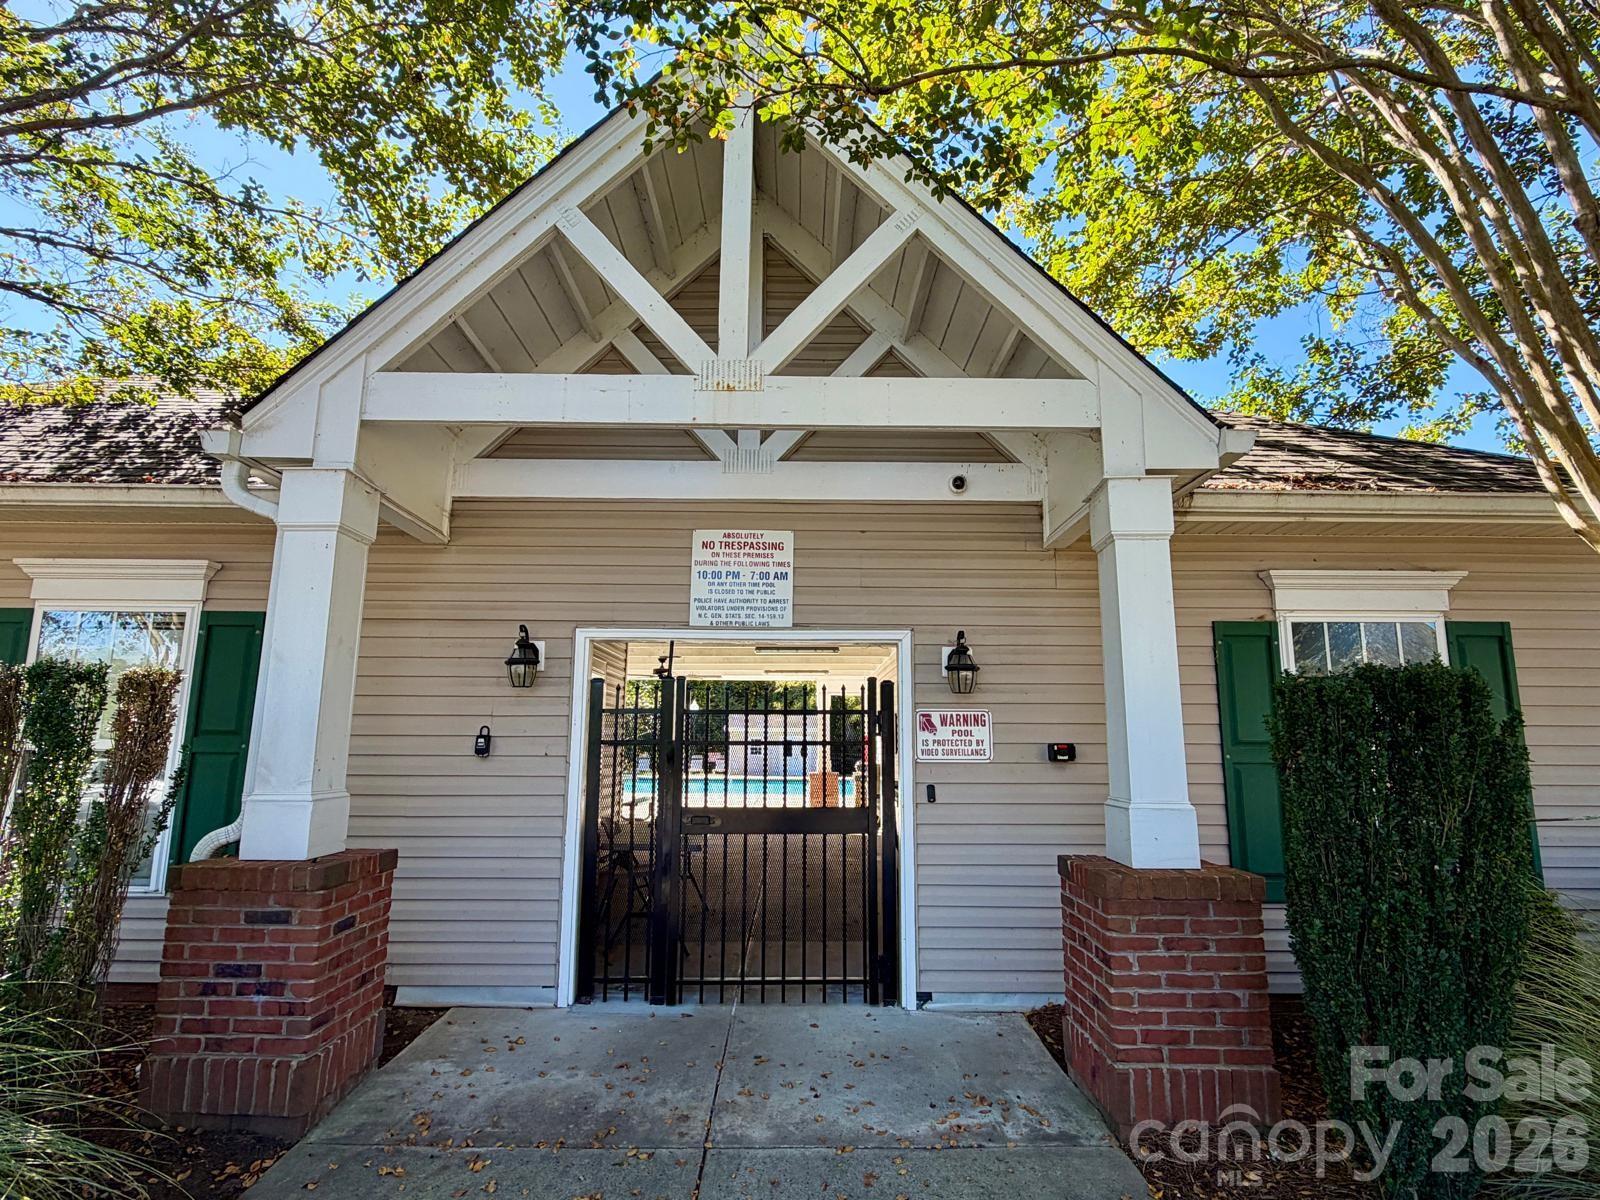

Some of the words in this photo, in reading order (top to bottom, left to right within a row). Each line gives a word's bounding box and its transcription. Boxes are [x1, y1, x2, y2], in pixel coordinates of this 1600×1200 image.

[702, 541, 715, 549] NO
[718, 541, 784, 551] TRESPASSING
[697, 570, 722, 579] 10:00
[726, 571, 740, 579] PM
[750, 571, 770, 580] 7:00
[773, 572, 788, 580] AM
[939, 714, 986, 727] WARNING
